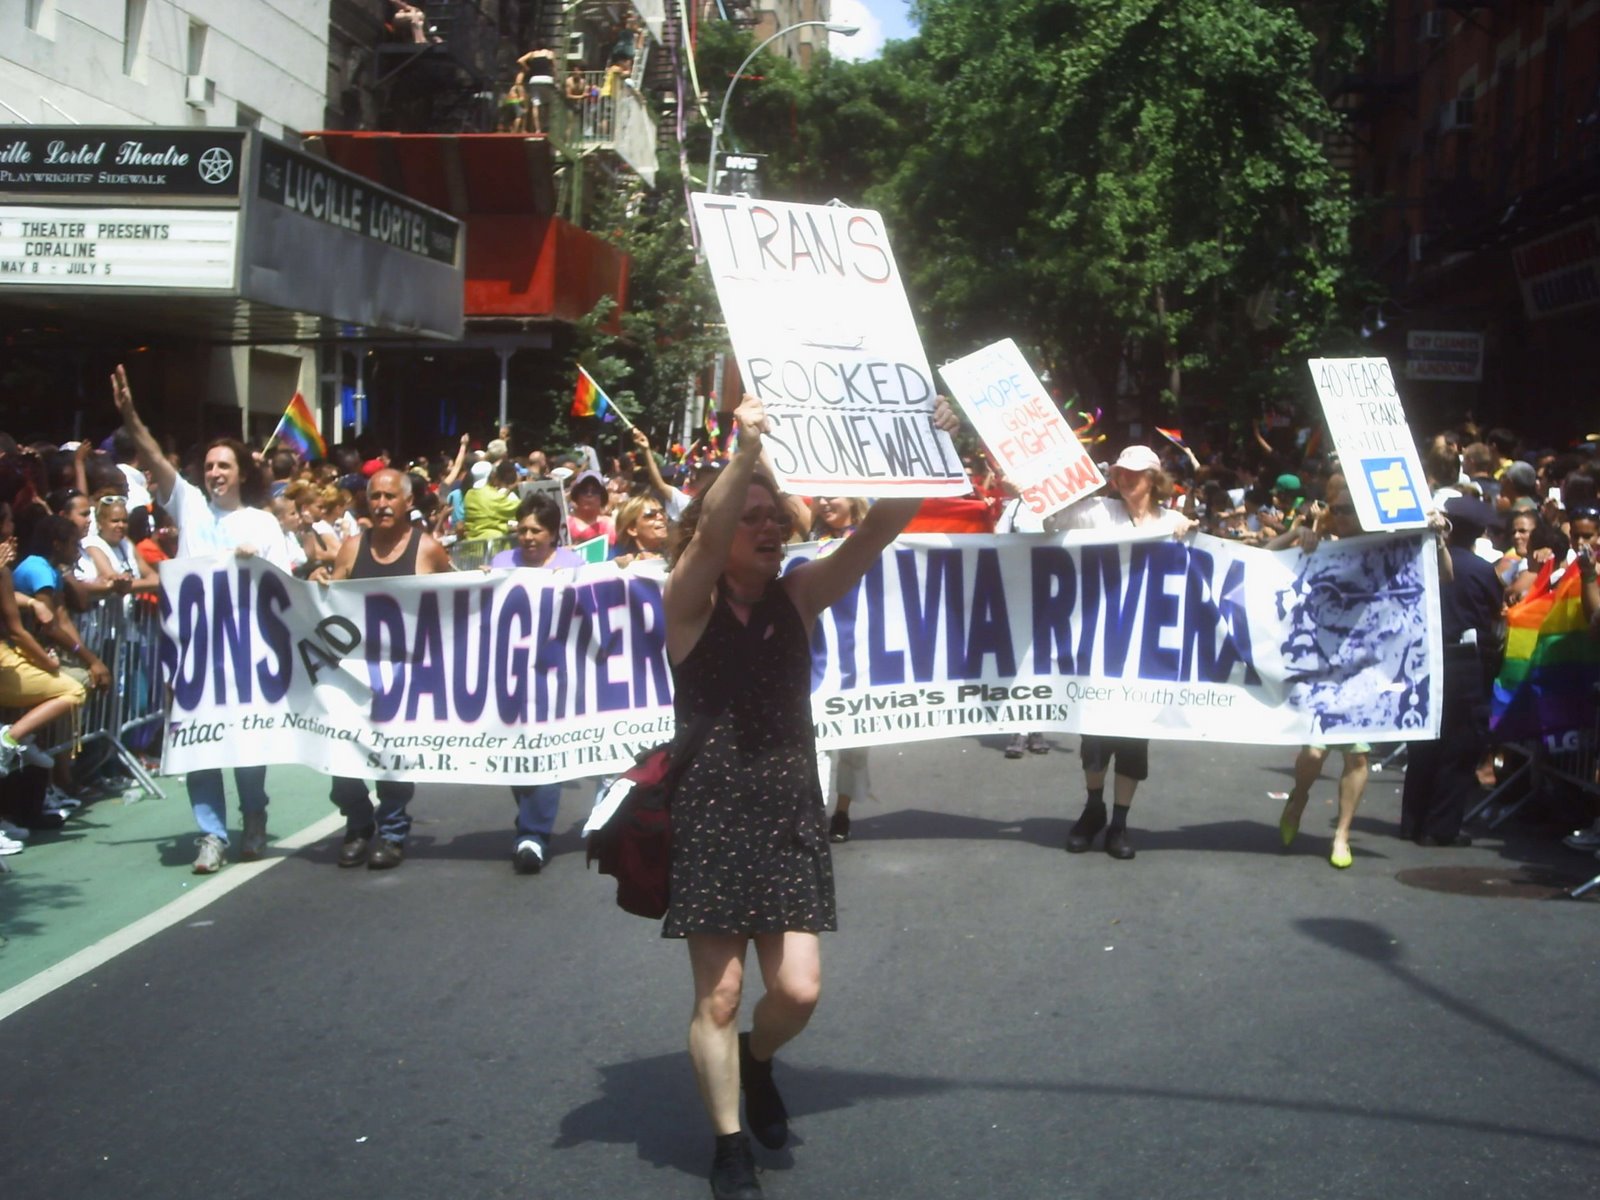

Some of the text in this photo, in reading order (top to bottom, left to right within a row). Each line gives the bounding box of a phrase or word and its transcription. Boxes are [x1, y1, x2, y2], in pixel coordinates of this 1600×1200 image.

[44, 139, 106, 165] Lortel
[115, 140, 190, 167] Theatre
[98, 171, 167, 185] SIDEWALK
[284, 159, 363, 232] LUCILLE
[369, 196, 429, 255] LORTEL
[22, 222, 86, 239] THEATER
[97, 223, 170, 240] PRESENTS
[25, 241, 97, 258] CORALINE
[704, 202, 891, 284] TRANS
[1, 261, 26, 274] MAY
[67, 262, 97, 275] JULY
[748, 357, 931, 406] ROCKED
[969, 373, 1031, 414] HOPE
[1320, 362, 1396, 398] 40 YEARS
[1001, 397, 1050, 432] GONE
[765, 412, 963, 478] STONEWALL
[998, 418, 1068, 467] FIGHT
[158, 569, 293, 712] SONS
[364, 576, 673, 725] DAUGHTER
[1030, 541, 1262, 686] RIVERA
[825, 681, 1236, 716] Sylvia's Place Queer Youth Shelter
[172, 721, 225, 748] ntac
[242, 713, 275, 730] the
[281, 713, 361, 742] National
[371, 730, 507, 751] Transgender
[513, 727, 605, 750] Advocacy
[486, 749, 568, 773] STREET
[813, 720, 844, 739] ON
[853, 703, 1069, 735] REVOLUTIONARIES
